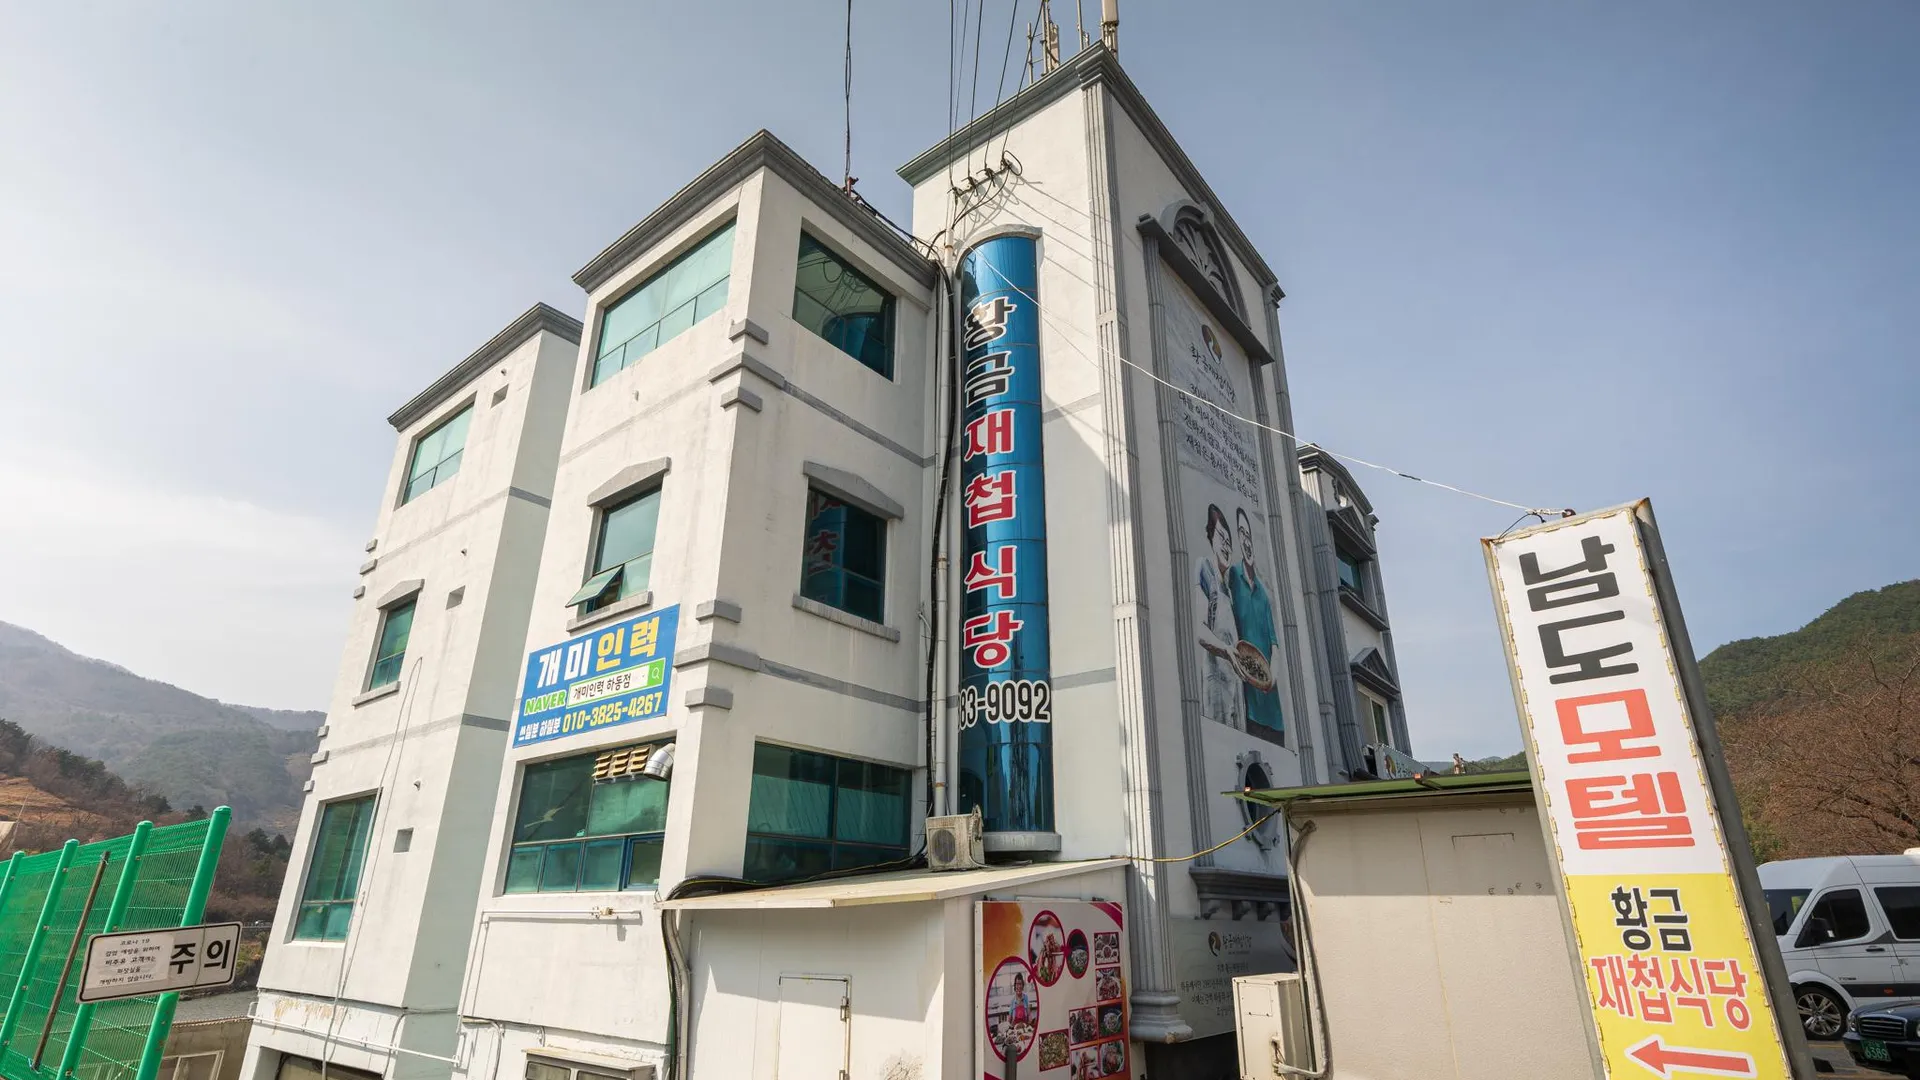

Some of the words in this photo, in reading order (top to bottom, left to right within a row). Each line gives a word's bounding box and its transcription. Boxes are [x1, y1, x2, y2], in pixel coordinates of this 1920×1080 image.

[606, 672, 631, 691] 하동점
[524, 690, 566, 716] NAVER
[562, 692, 663, 733] 010-3825-4267
[1611, 885, 1692, 952] 황금
[170, 939, 231, 974] 주의
[1591, 953, 1750, 1030] 재첩식당
